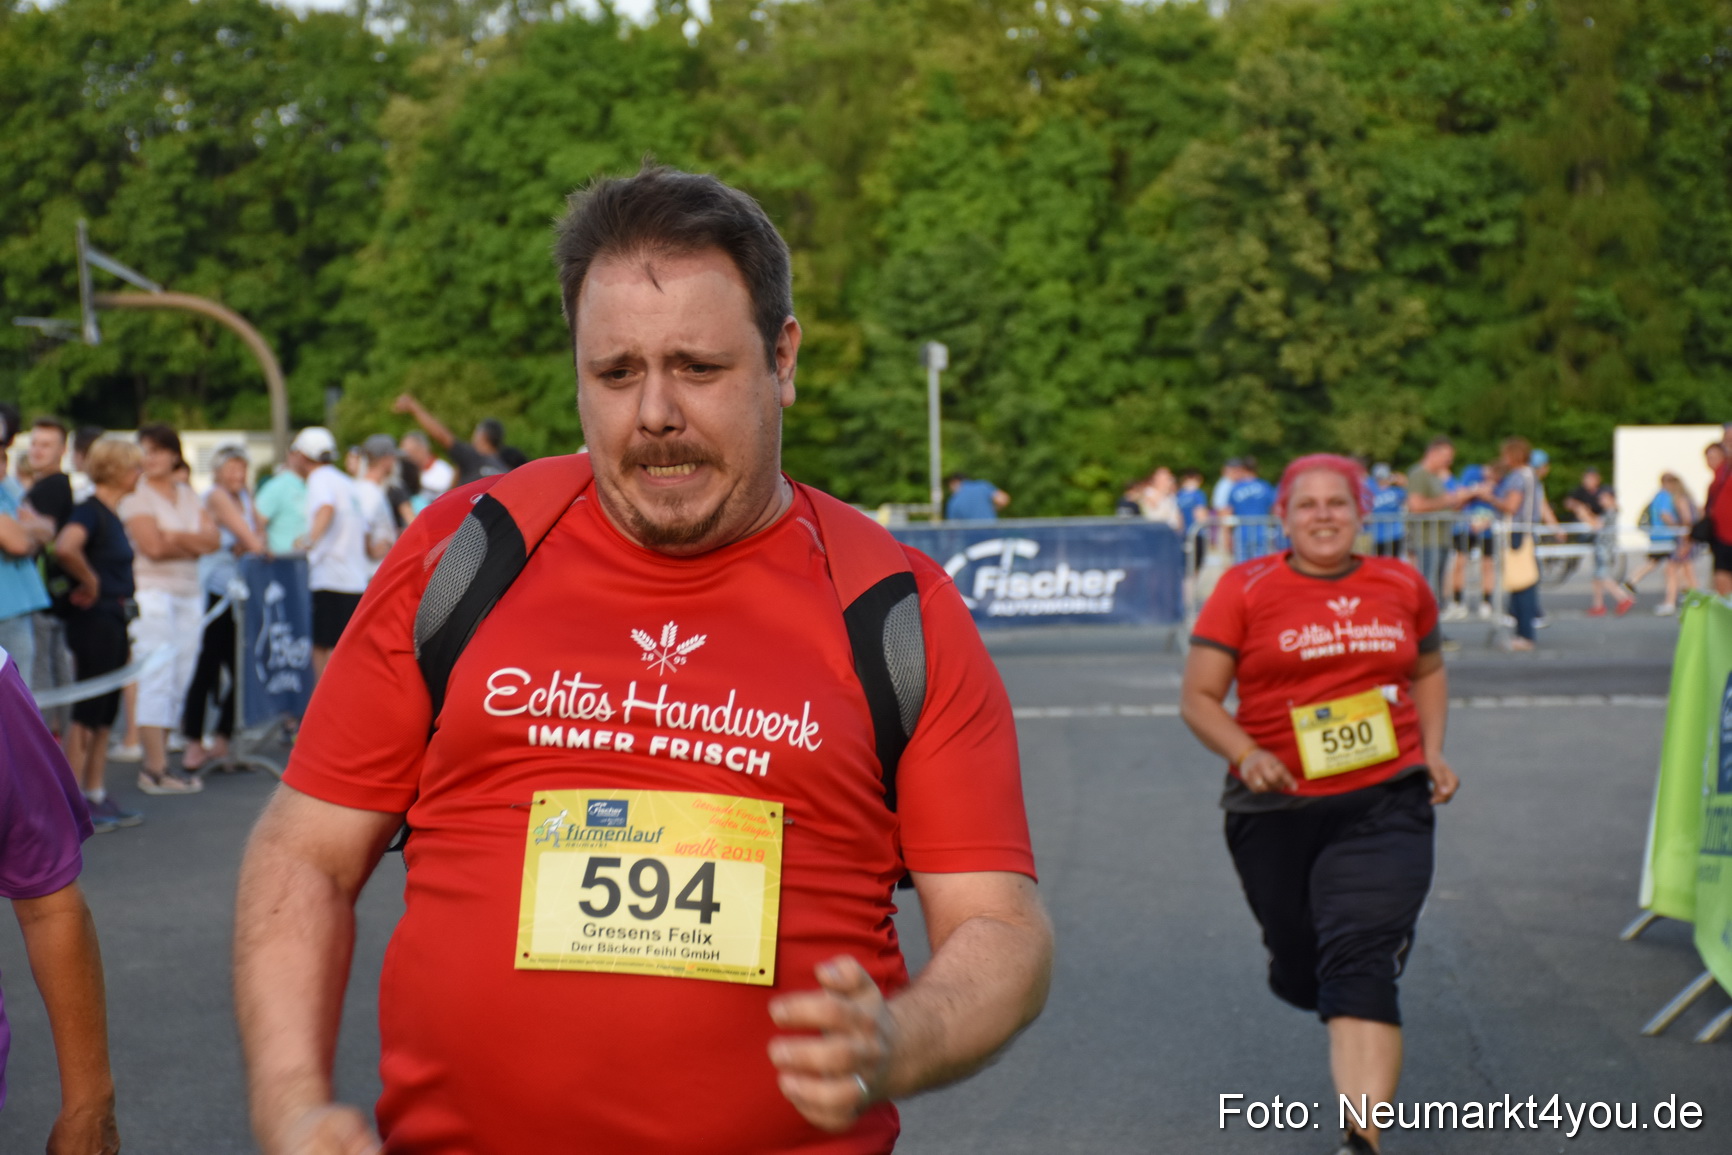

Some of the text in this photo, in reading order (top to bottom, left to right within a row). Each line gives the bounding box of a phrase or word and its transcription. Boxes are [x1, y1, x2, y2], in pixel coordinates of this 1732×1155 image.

[973, 561, 1126, 600] Fischer
[641, 652, 687, 666] 18 95
[483, 667, 822, 752] Echtes Handwerk
[528, 725, 770, 777] IMMER FRISCH
[1321, 720, 1373, 754] 590
[565, 825, 665, 843] firmenlauf
[675, 838, 766, 863] walk 2019
[578, 856, 721, 925] 594
[583, 922, 713, 946] Gresens Felix
[571, 941, 720, 961] Der Bäcker Feihl GmbH
